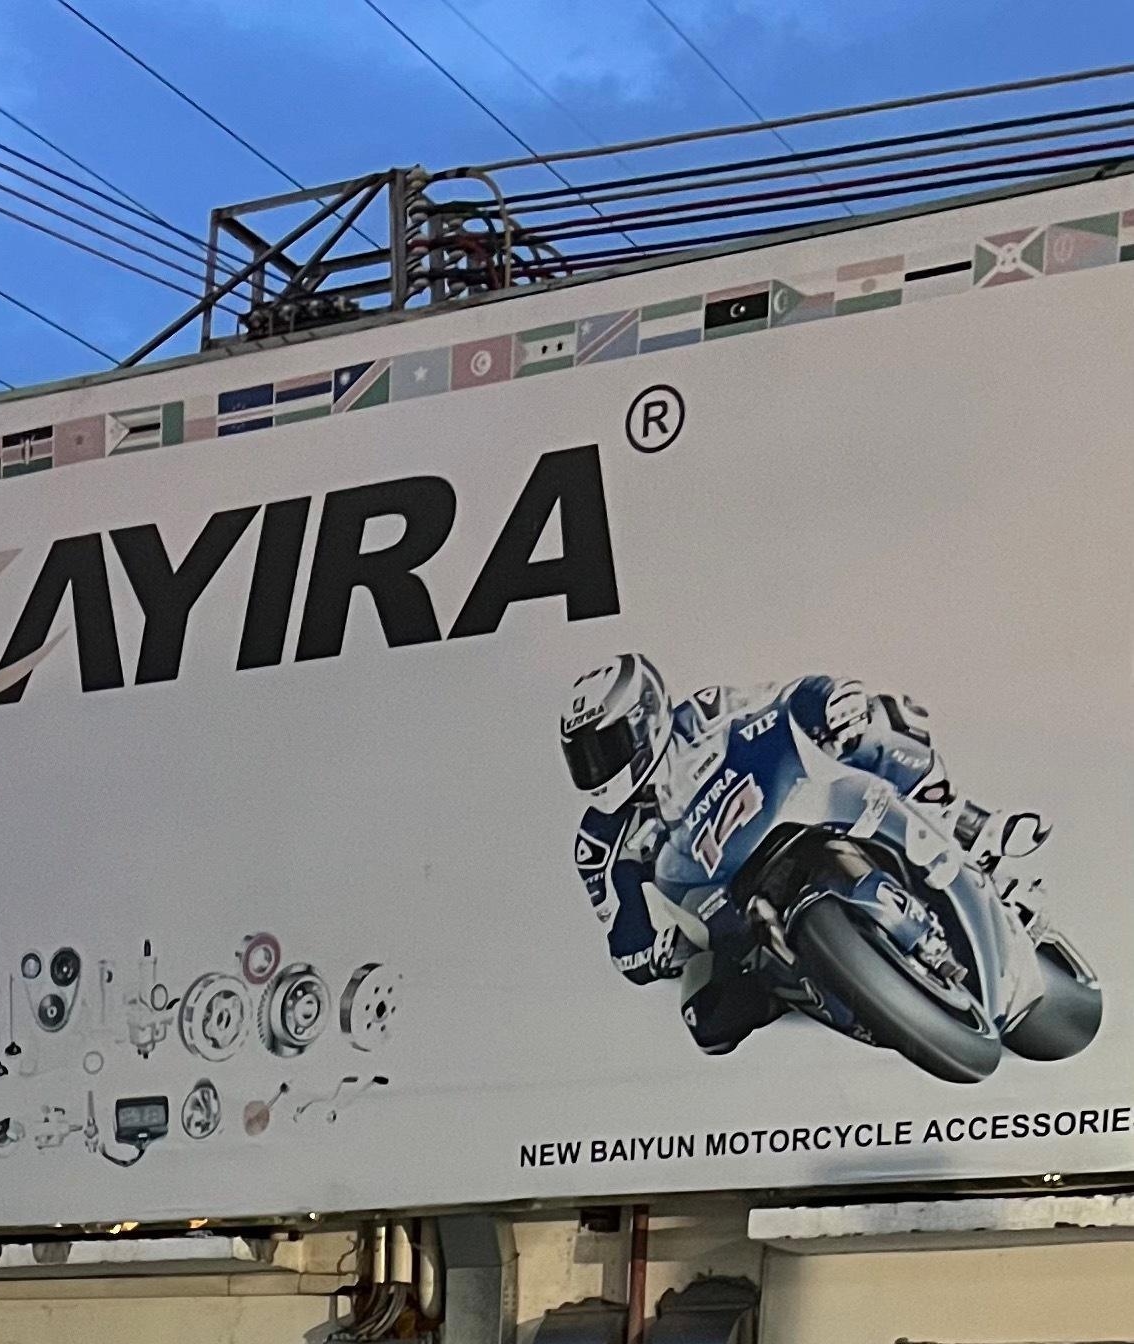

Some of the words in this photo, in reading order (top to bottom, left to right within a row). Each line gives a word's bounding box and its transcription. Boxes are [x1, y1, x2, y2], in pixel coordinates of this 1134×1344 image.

[738, 709, 779, 742] VIP
[684, 768, 738, 832] KAYIRA
[691, 773, 765, 880] 14
[520, 1141, 581, 1167] NEW
[590, 1134, 694, 1163] BAIYUN
[706, 1121, 912, 1157] MOTORCYCLE
[922, 1107, 1133, 1143] ACCESSORIE
